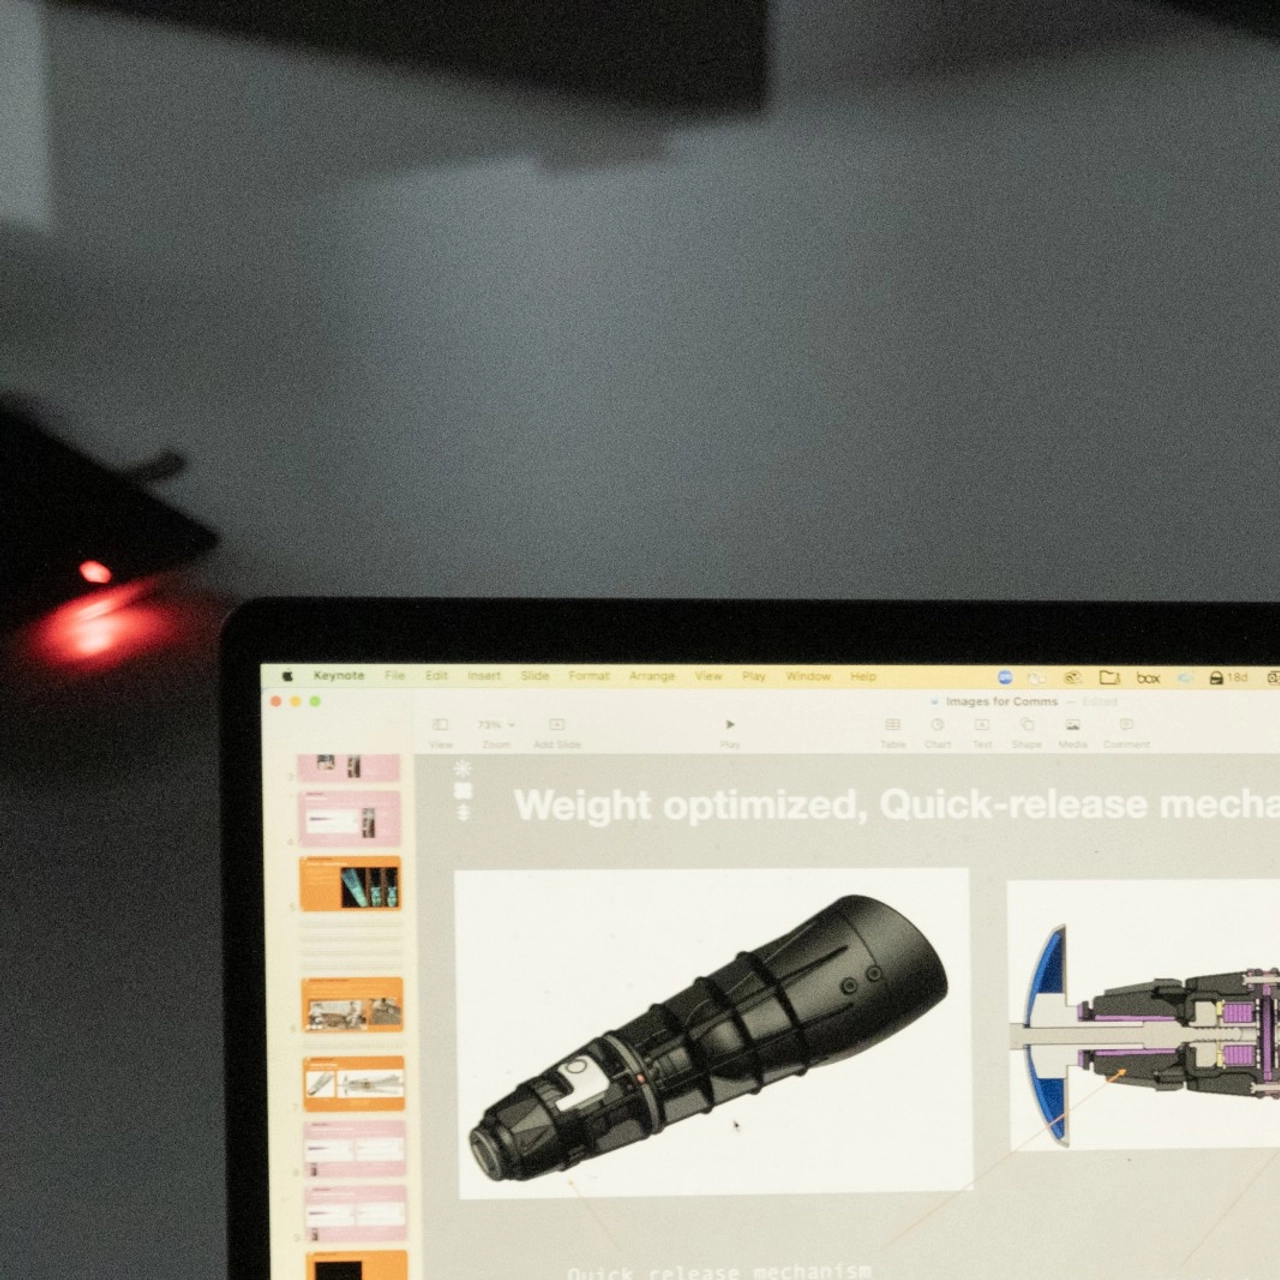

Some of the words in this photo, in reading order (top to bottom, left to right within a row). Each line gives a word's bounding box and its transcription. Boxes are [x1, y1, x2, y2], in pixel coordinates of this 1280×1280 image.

[314, 670, 364, 682] Keynote
[385, 671, 405, 680] File
[426, 671, 448, 680] Edit
[468, 671, 500, 680] Insert
[521, 671, 550, 681] Slide
[570, 672, 610, 681] Format
[630, 672, 675, 682] Arrange
[694, 671, 722, 681] View
[742, 671, 766, 683] Play
[786, 672, 830, 682] Window
[851, 672, 876, 683] Help
[1137, 672, 1161, 684] box
[1227, 673, 1248, 682] 18d
[946, 697, 989, 708] Images
[993, 697, 1010, 706] for
[1014, 697, 1058, 706] Comms
[430, 740, 453, 749] View
[482, 740, 511, 749] Zoom
[534, 740, 554, 749] Add
[557, 740, 582, 749] Slide
[720, 740, 740, 750] Play
[881, 740, 906, 749] Table
[924, 740, 952, 749] Chart
[973, 740, 992, 749] Text
[1012, 740, 1042, 750] Shape
[1059, 740, 1088, 749] Media
[1104, 740, 1150, 749] Comment
[515, 788, 651, 829] Weight
[665, 788, 869, 827] optimized,
[881, 787, 1148, 820] Quick-release
[754, 1262, 872, 1280] mechanism
